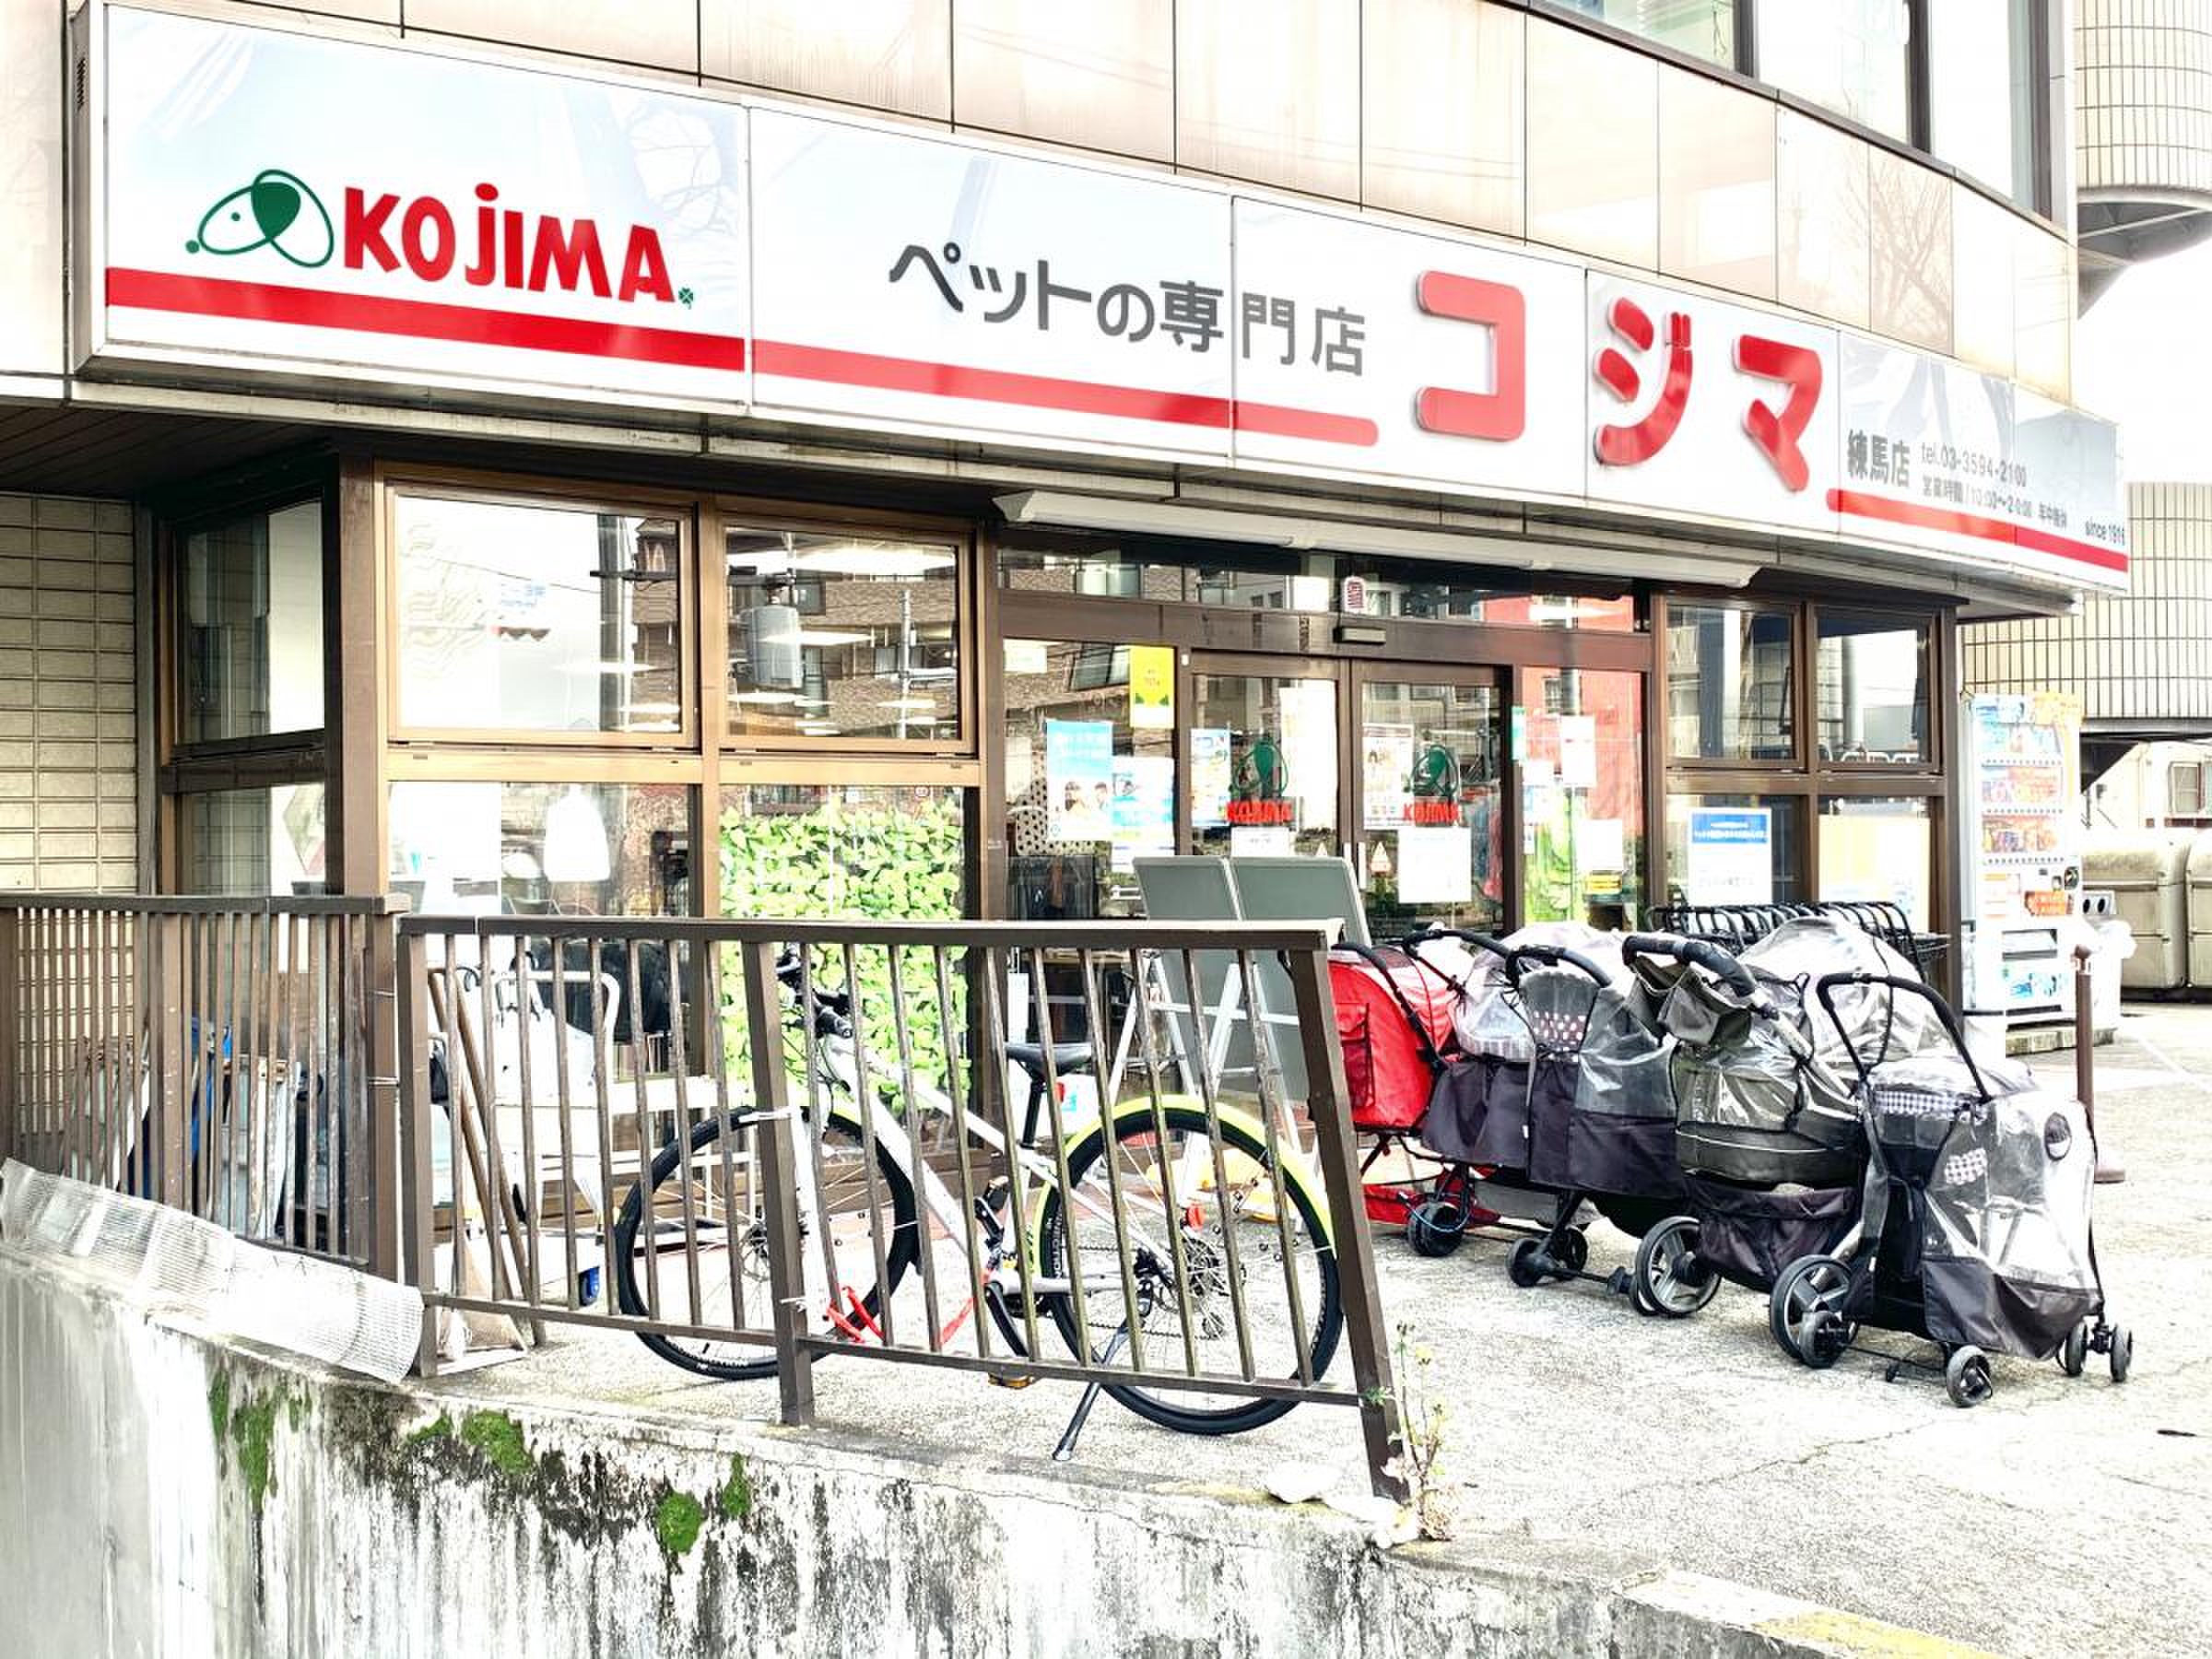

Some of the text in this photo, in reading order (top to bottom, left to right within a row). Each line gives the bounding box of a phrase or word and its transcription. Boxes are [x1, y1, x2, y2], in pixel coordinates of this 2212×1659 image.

[888, 241, 1823, 492] ペットの専門店 コジマ
